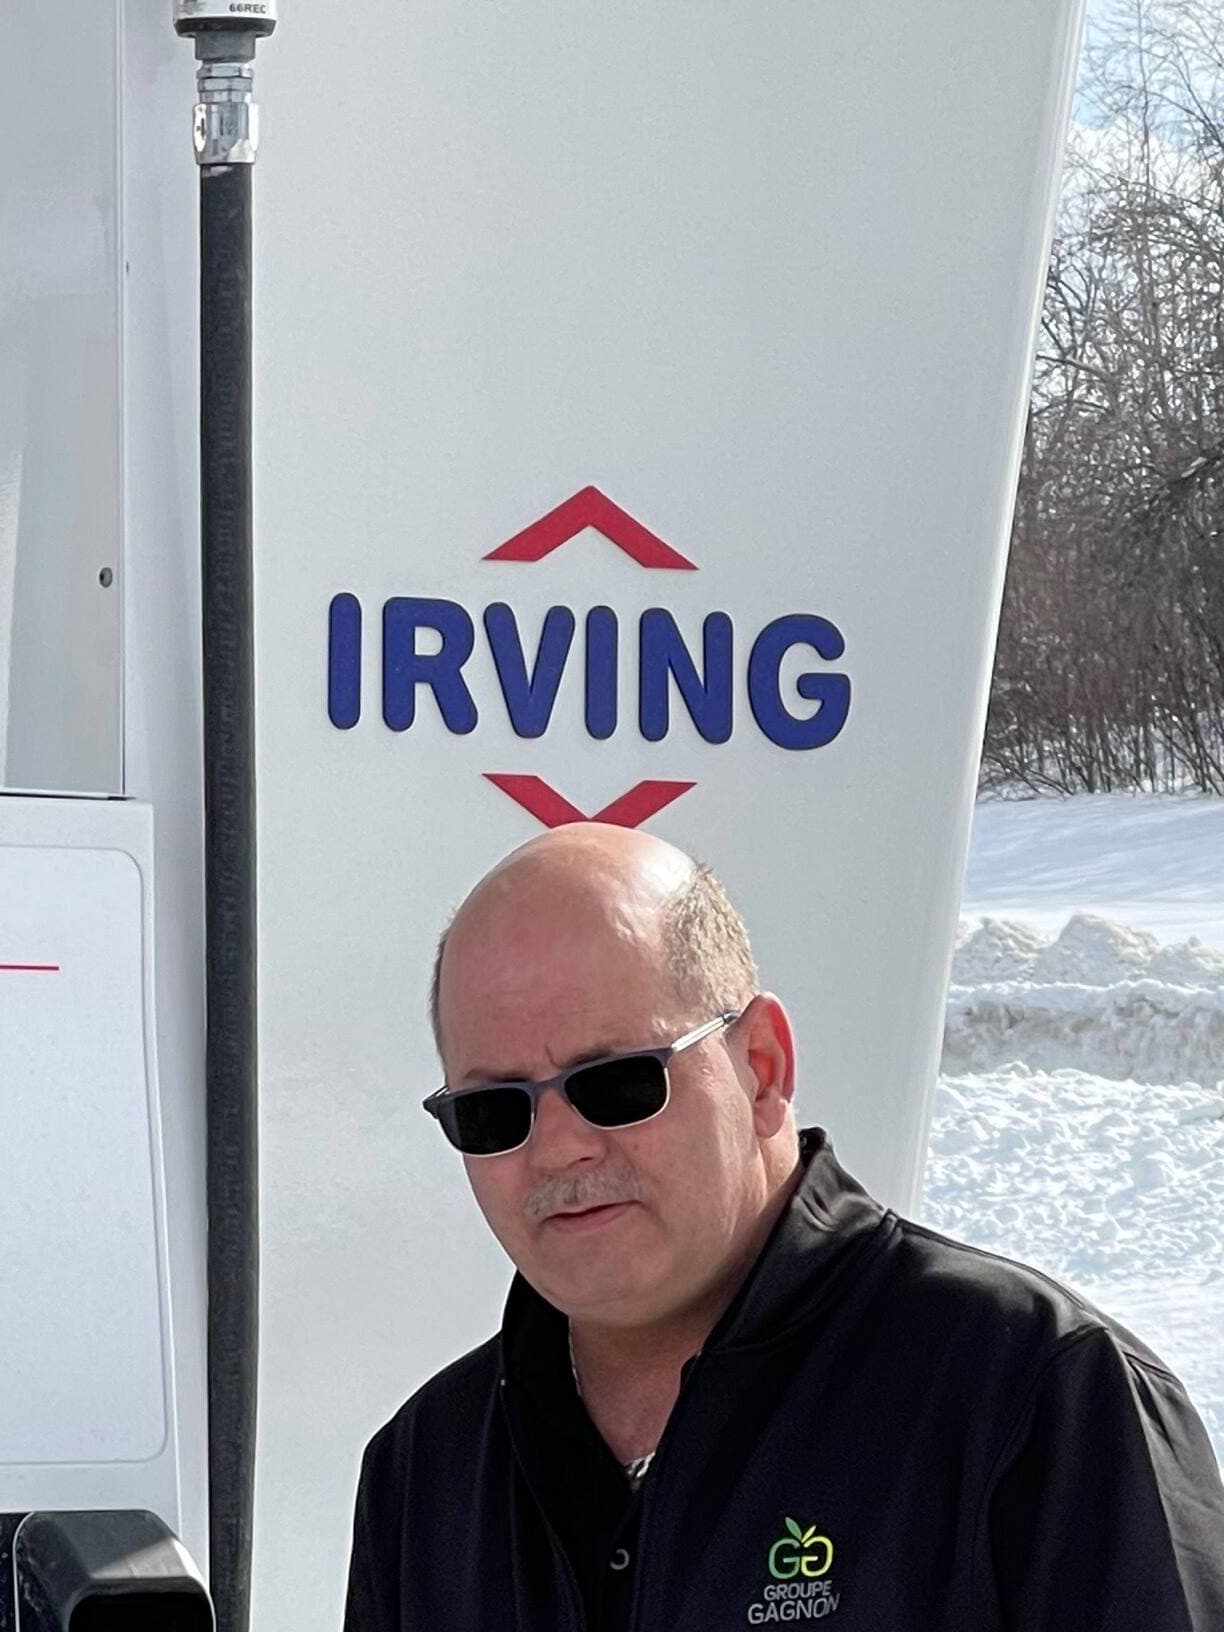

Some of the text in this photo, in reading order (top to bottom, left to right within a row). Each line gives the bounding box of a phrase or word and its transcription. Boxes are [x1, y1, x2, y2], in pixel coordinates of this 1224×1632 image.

[328, 592, 851, 750] IRVING
[764, 1580, 832, 1601] GROUPE
[747, 1593, 840, 1624] GAGNON
